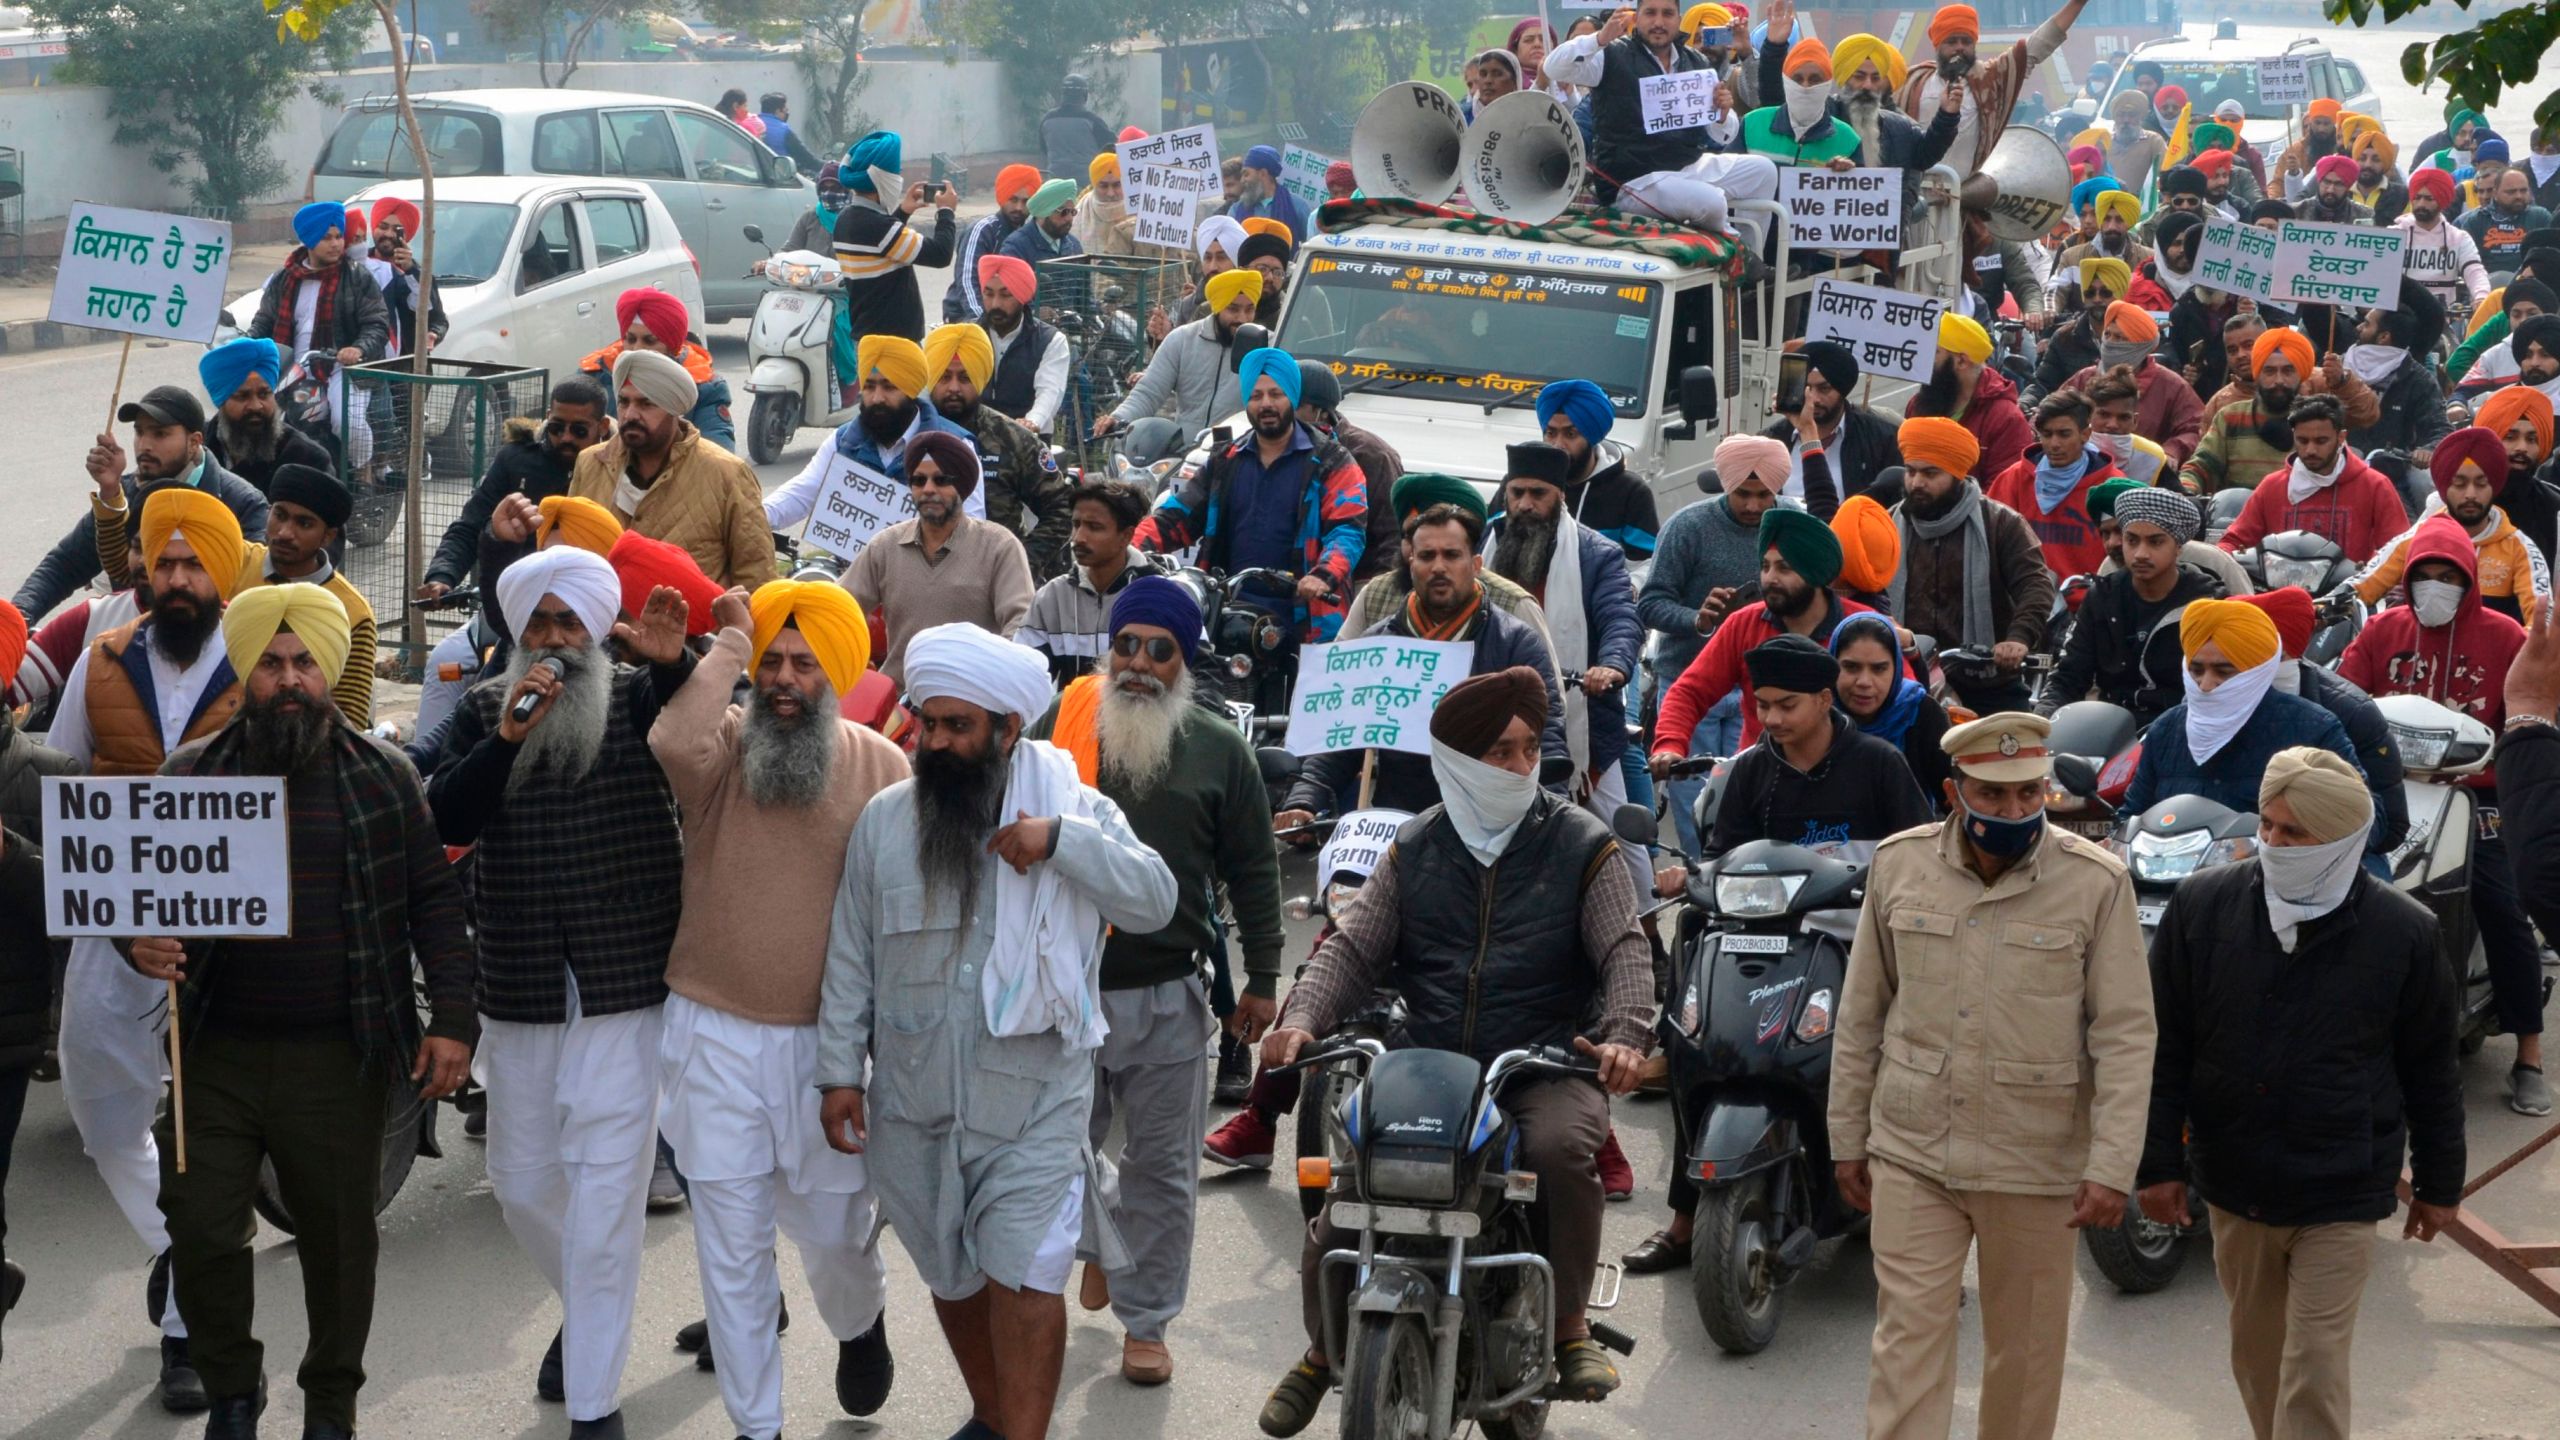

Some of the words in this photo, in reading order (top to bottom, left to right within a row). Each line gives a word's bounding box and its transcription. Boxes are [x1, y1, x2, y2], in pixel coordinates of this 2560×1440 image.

[1547, 103, 1580, 198] PREET
[1146, 167, 1160, 186] No
[1163, 170, 1198, 192] Farmer
[1798, 173, 1884, 191] Farmer
[1142, 193, 1156, 213] No
[1158, 196, 1184, 217] Food
[1791, 198, 1825, 216] We
[1834, 198, 1889, 216] Filed
[73, 216, 154, 265] ਕਿਸਾਨ
[163, 226, 184, 269] ਹੈ
[193, 236, 224, 273] ਤਾਂ
[1139, 219, 1152, 238] No
[1155, 222, 1188, 244] Future
[1790, 224, 1822, 241] he
[1830, 224, 1898, 242] World
[2282, 222, 2337, 246] ਕਿਸਾਨ
[2308, 250, 2368, 276] ਏਕਤਾ
[2404, 249, 2456, 270] HICAGO
[87, 286, 156, 323] ਜਹਾਨ
[166, 284, 187, 328] ਹੈ
[1817, 281, 1877, 321] ਕਿਸਾਨ
[843, 470, 896, 506] ਲੜਾਈ
[827, 491, 879, 530] ਕਿਸਾਨ
[812, 520, 850, 549] ਲੜਾਈ
[1326, 645, 1387, 673] ਕਿਸਾਨ
[1395, 648, 1440, 682] ਮਾਰੂ
[1304, 683, 1344, 713] ਕਾਲੇ
[1326, 721, 1356, 748] ਰੱਦ
[1364, 716, 1401, 746] ਕਰੋ
[59, 782, 112, 820] No
[129, 782, 276, 820] Farmer
[1354, 818, 1397, 843] Supp
[61, 836, 114, 874] No
[131, 836, 230, 874] Food
[1328, 847, 1378, 870] Farm
[63, 889, 116, 927] No
[132, 889, 268, 927] Future
[1418, 1116, 1443, 1126] Hero
